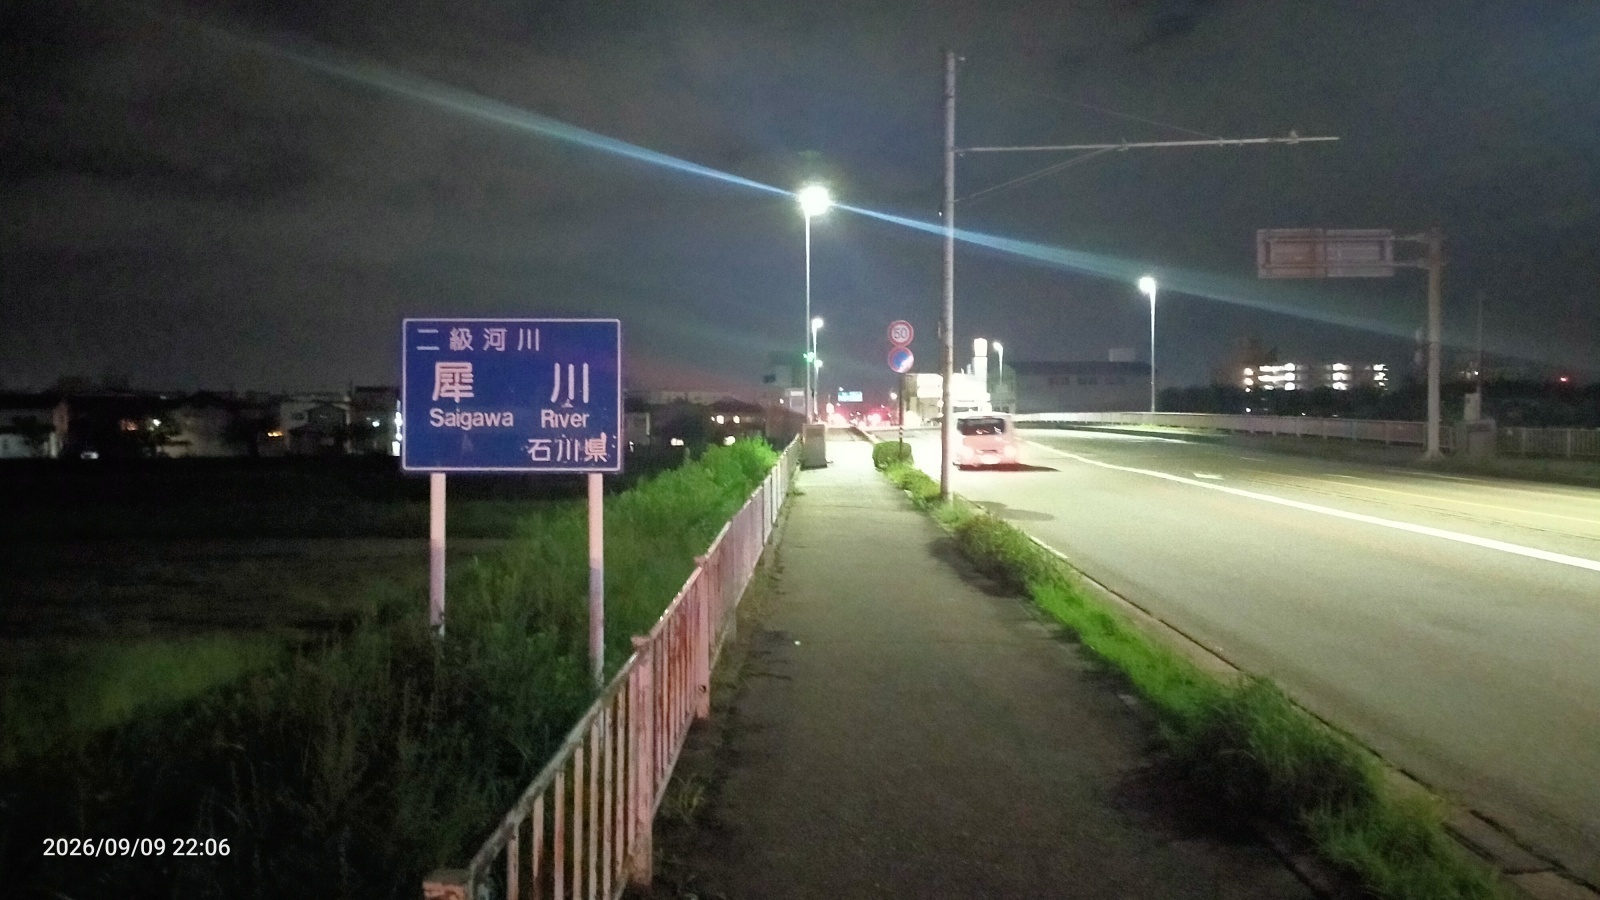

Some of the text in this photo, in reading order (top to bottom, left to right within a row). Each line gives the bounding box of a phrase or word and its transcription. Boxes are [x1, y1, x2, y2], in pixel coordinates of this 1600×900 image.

[416, 327, 540, 351] 二級河川
[894, 327, 908, 339] 50
[429, 408, 590, 431] Saigawa River
[527, 434, 607, 462] 石川県
